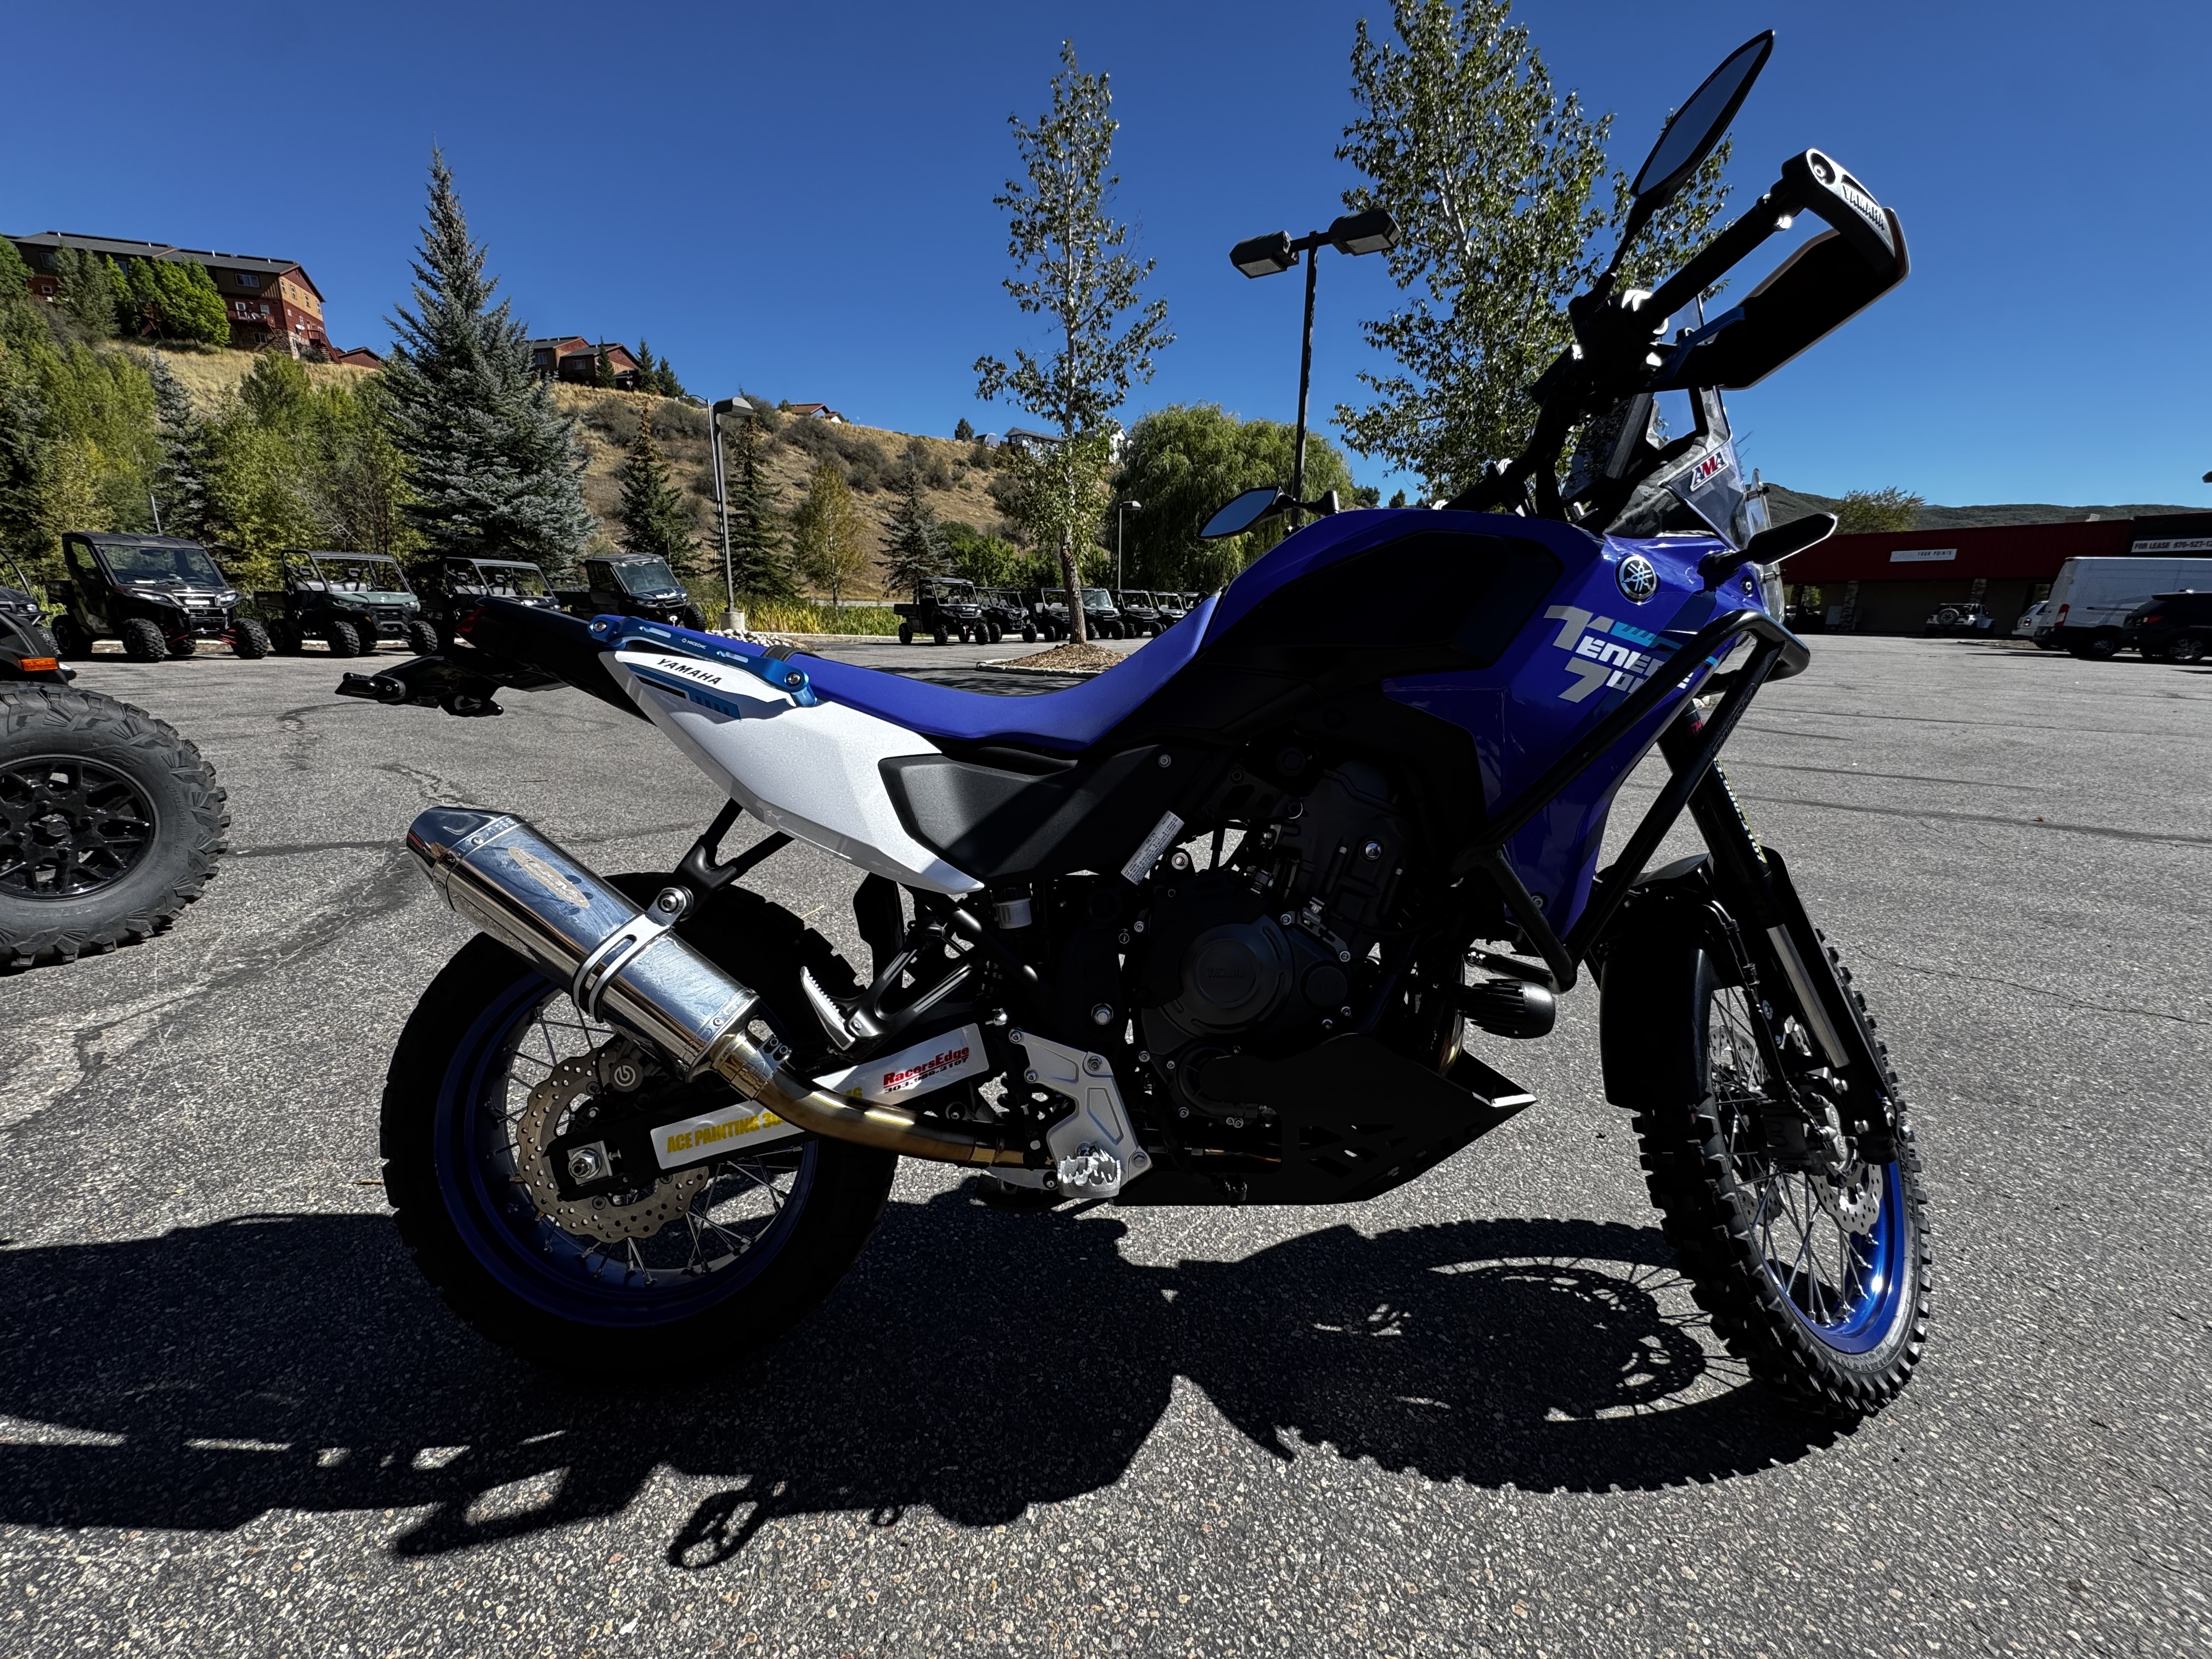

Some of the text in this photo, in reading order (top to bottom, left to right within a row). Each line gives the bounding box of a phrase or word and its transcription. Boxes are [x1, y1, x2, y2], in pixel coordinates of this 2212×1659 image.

[1842, 184, 1885, 231] YAMAHA
[1693, 452, 1727, 486] AMA
[657, 658, 723, 685] YAMAHA
[883, 1047, 970, 1086] RacersEdge
[667, 1132, 693, 1153] ACE
[695, 1115, 760, 1147] PAINTING
